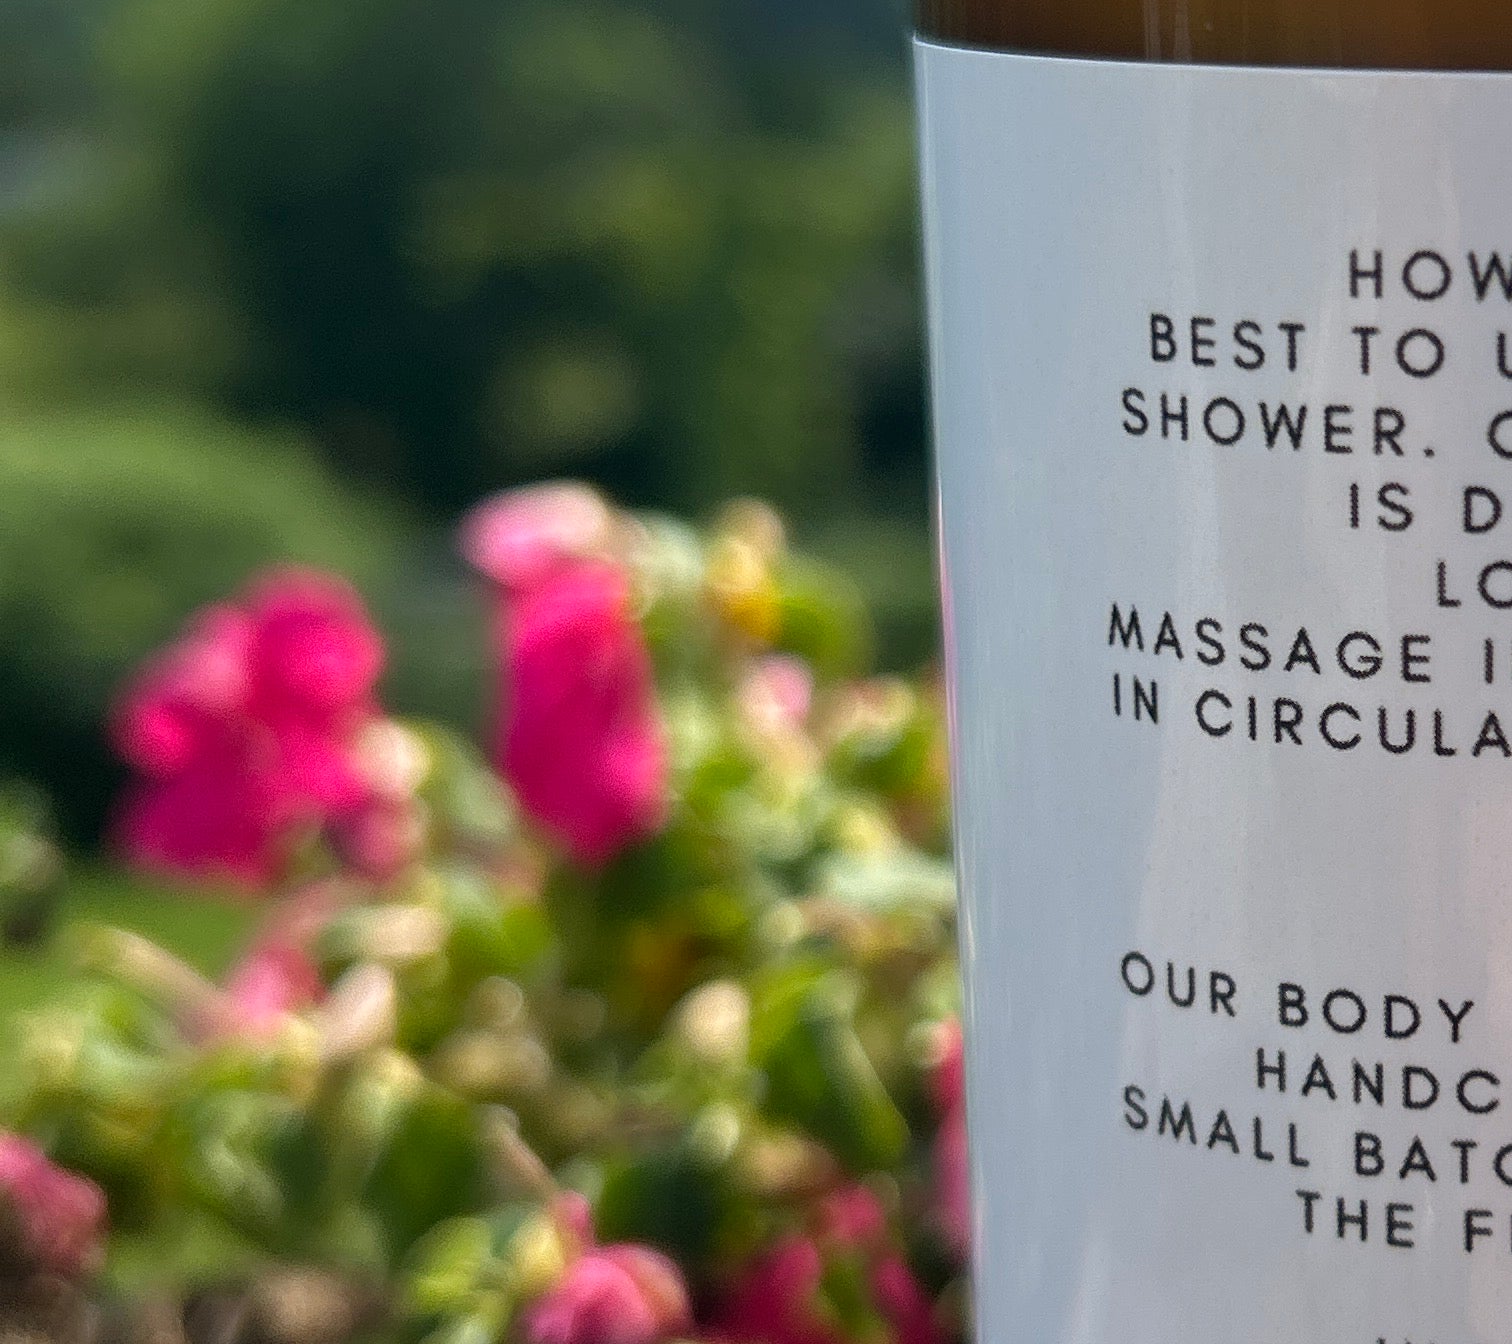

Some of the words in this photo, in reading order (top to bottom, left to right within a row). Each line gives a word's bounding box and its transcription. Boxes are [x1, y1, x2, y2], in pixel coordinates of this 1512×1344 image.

[1150, 313, 1305, 372] BEST
[1351, 326, 1445, 379] TO
[1122, 387, 1435, 458] SHOWER.
[1349, 482, 1414, 532] IS
[1108, 602, 1431, 683] MASSAGE
[1113, 673, 1158, 725] IN
[1121, 951, 1236, 1017] OUR
[1278, 982, 1474, 1044] BODY
[1124, 1084, 1310, 1168] SMALL
[1295, 1189, 1414, 1249] THE
